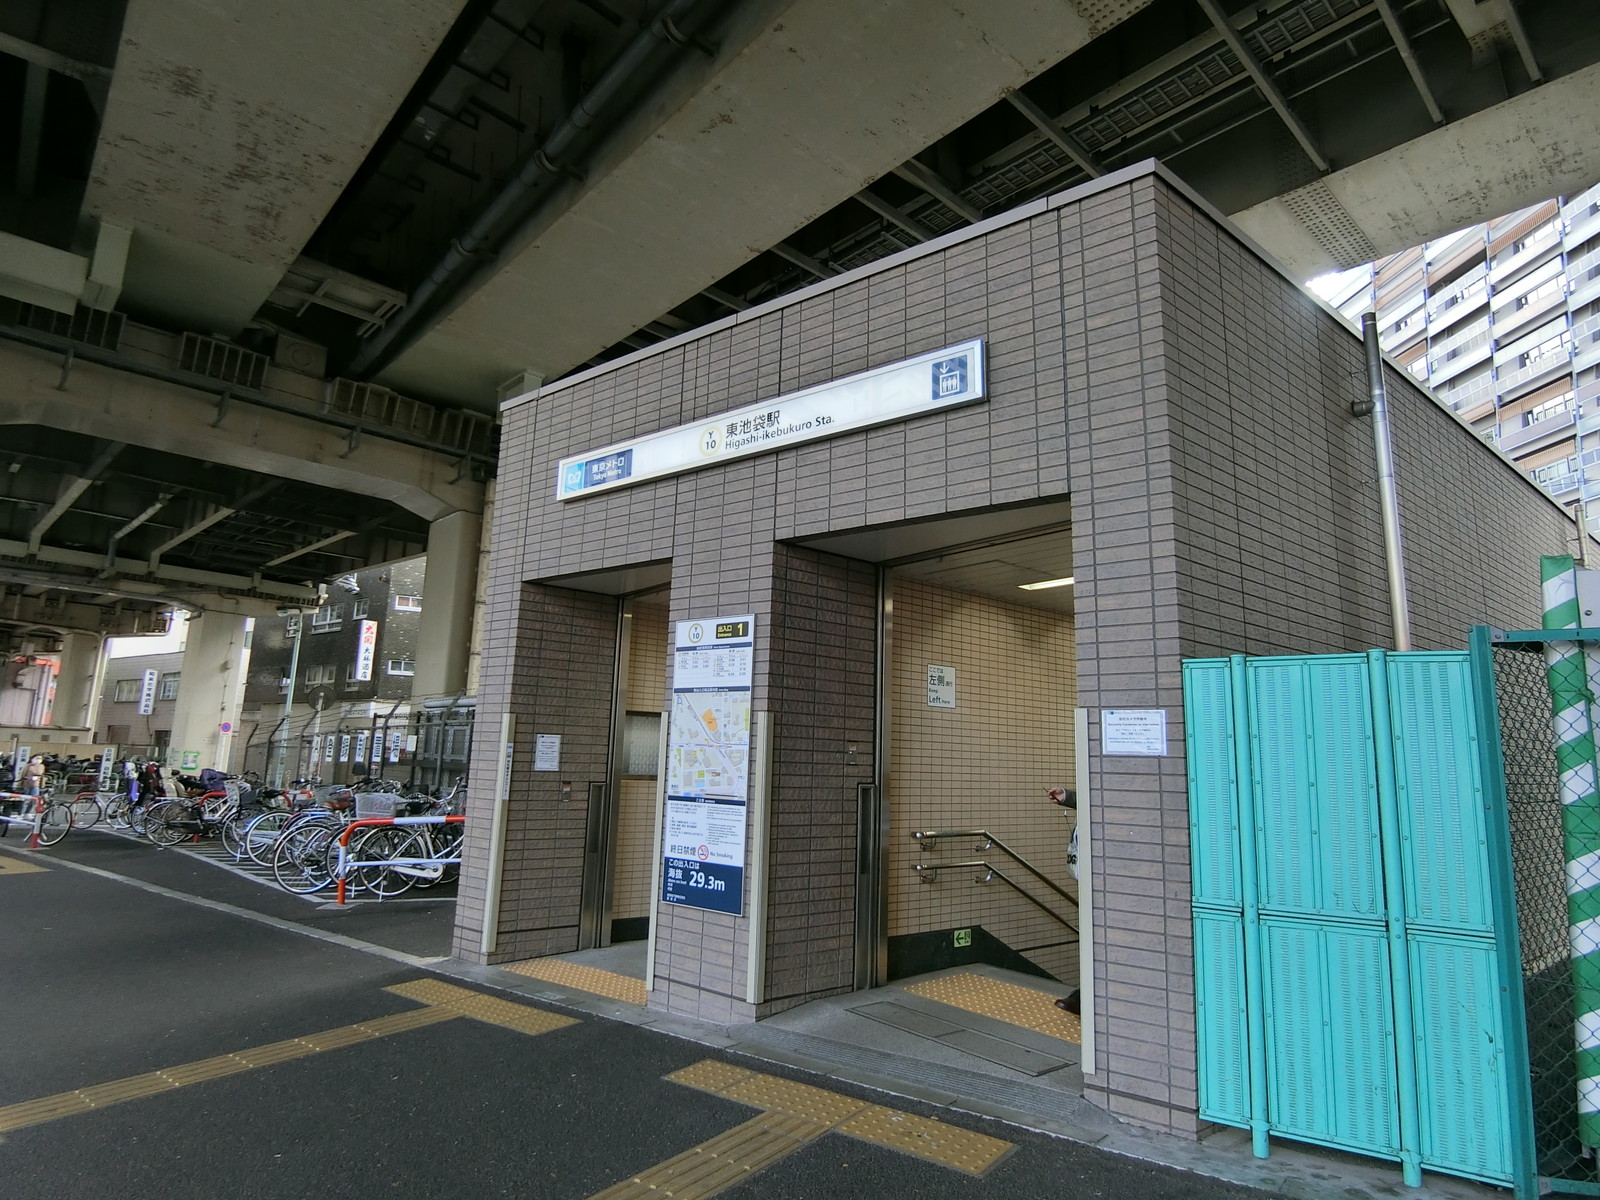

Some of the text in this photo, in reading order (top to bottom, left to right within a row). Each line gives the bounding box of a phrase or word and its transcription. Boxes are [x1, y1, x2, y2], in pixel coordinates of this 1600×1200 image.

[725, 410, 780, 439] 東池袋駅
[708, 431, 714, 439] Y
[725, 416, 835, 450] Higashi-ikebukuro Sta.
[706, 440, 717, 450] 10
[591, 457, 625, 474] 東京メトロ
[593, 469, 622, 481] Tokyo Metro
[737, 623, 743, 636] 1
[692, 632, 700, 640] 10
[671, 845, 696, 856] 終日禁煙
[669, 859, 700, 869] この出入口は
[668, 868, 683, 879] 海抜
[689, 871, 725, 891] 29.3m
